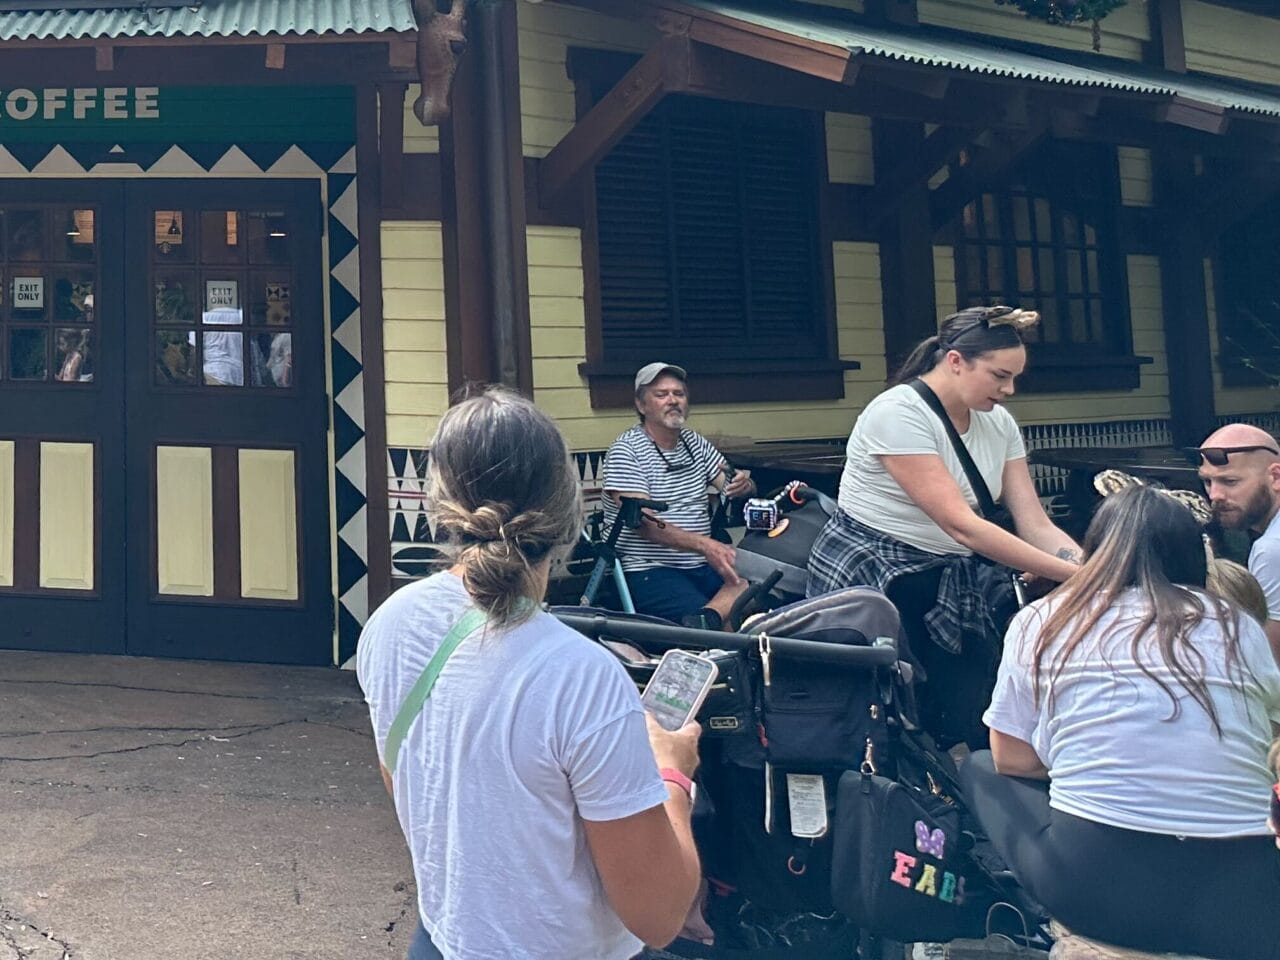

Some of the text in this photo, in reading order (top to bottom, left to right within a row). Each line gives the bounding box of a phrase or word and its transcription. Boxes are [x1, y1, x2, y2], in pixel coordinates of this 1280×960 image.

[19, 283, 39, 292] EXIT
[212, 287, 232, 296] EXIT
[17, 292, 40, 301] ONLY
[210, 296, 233, 305] ONLY
